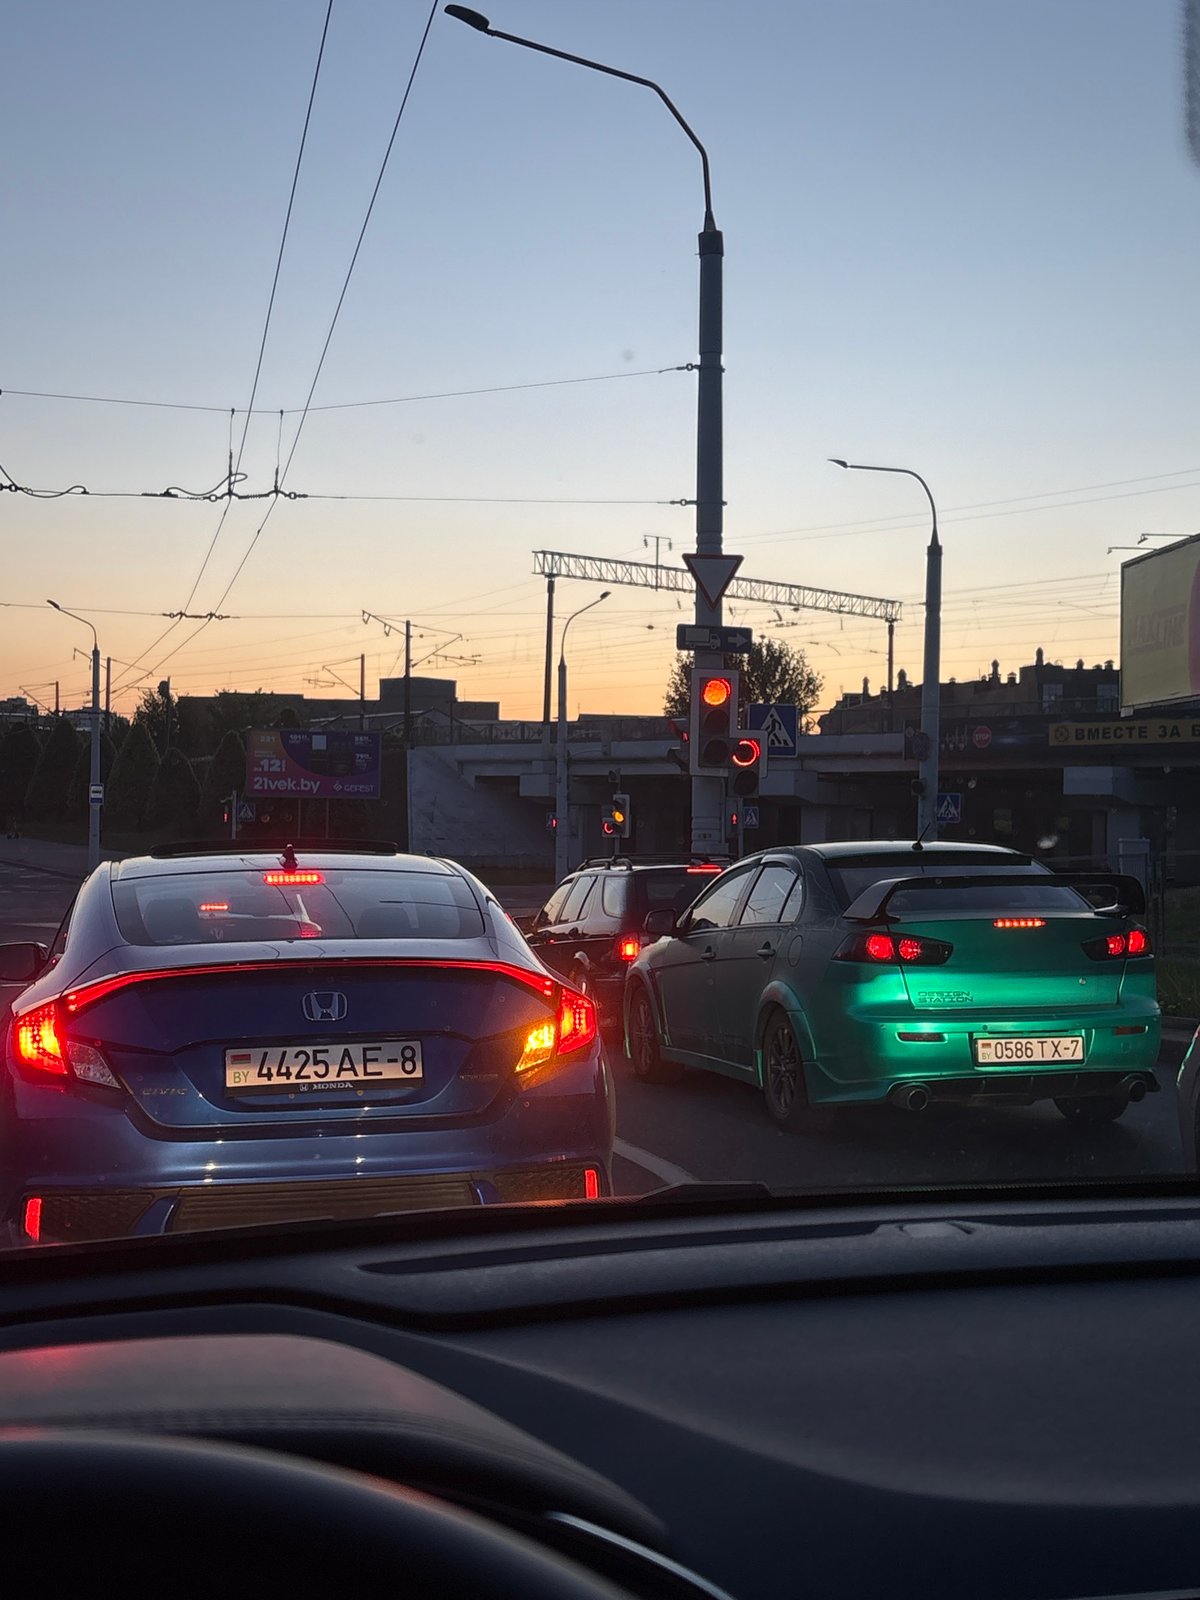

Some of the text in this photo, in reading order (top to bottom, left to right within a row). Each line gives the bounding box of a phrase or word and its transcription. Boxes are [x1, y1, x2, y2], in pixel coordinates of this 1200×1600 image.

[1075, 726, 1148, 740] ВМЕСТЕ
[1158, 725, 1181, 737] ЗА
[254, 777, 320, 794] 21vek.by
[233, 1071, 250, 1084] BY
[312, 1082, 354, 1090] HONDA
